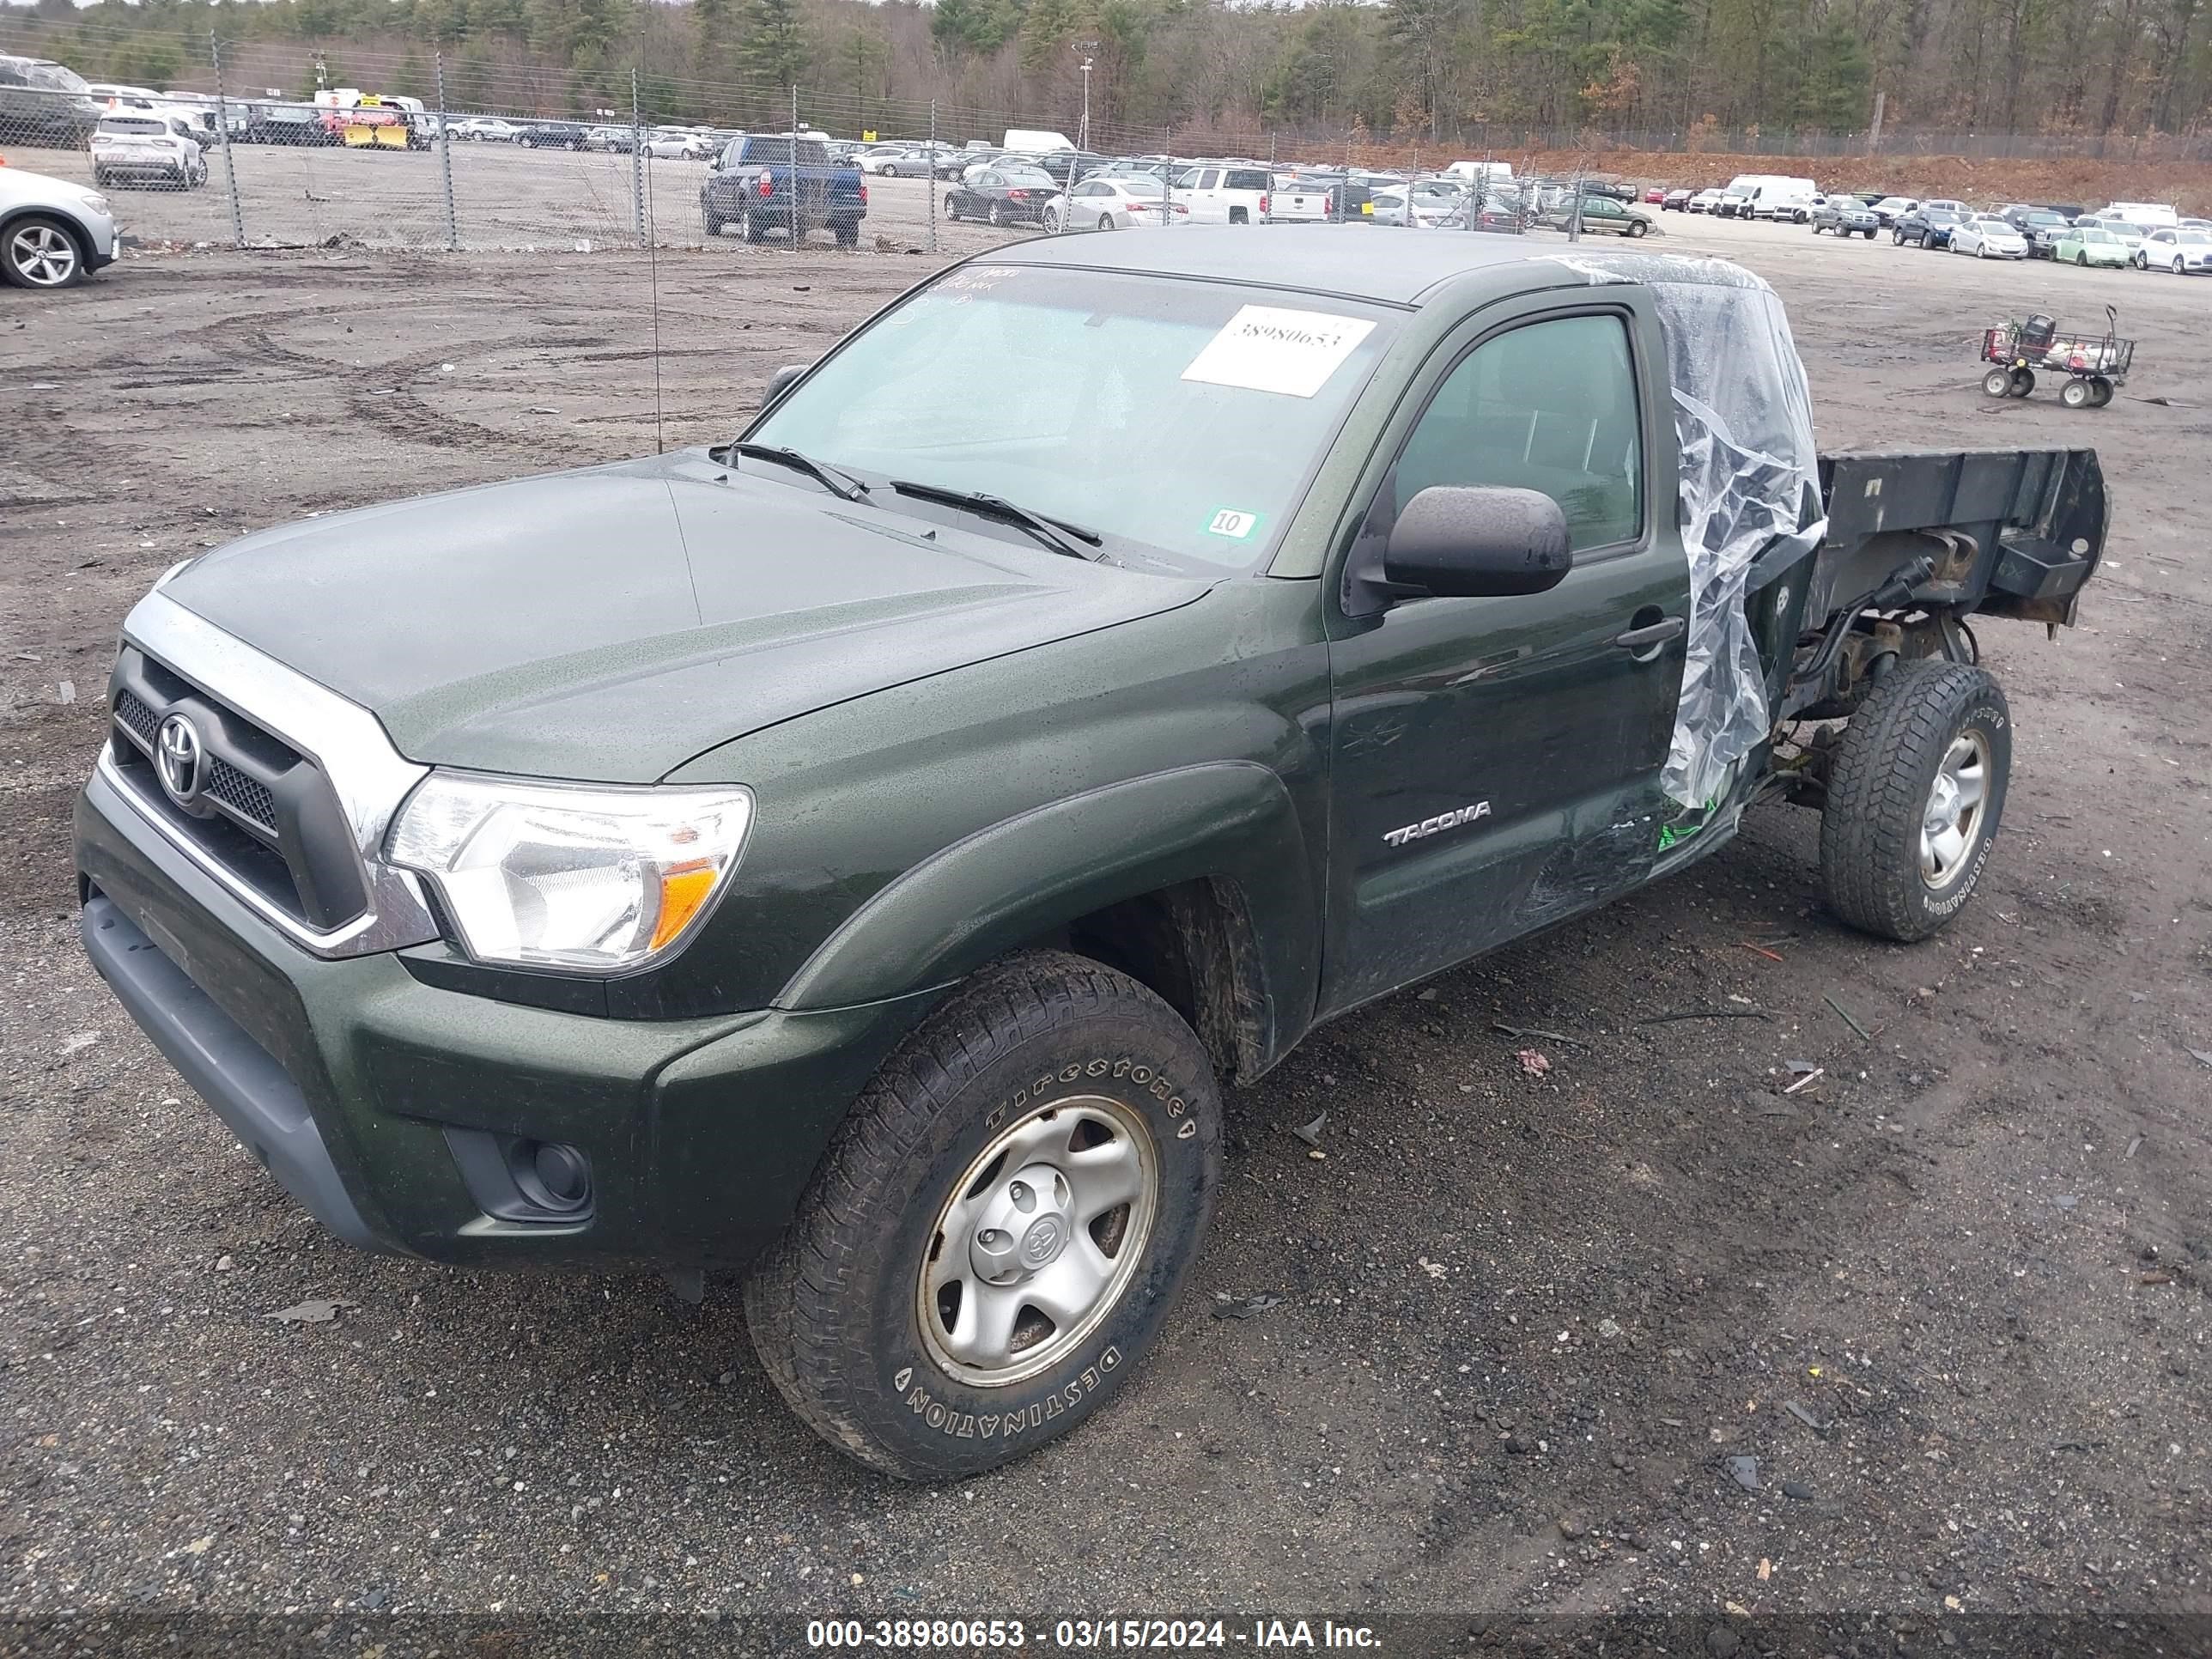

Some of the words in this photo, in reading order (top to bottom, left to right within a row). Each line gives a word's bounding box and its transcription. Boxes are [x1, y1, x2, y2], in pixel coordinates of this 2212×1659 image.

[1233, 323, 1342, 347] 38980653
[1212, 513, 1241, 532] 10
[1382, 800, 1492, 848] TACOMA
[906, 1346, 1123, 1439] DESTINATION
